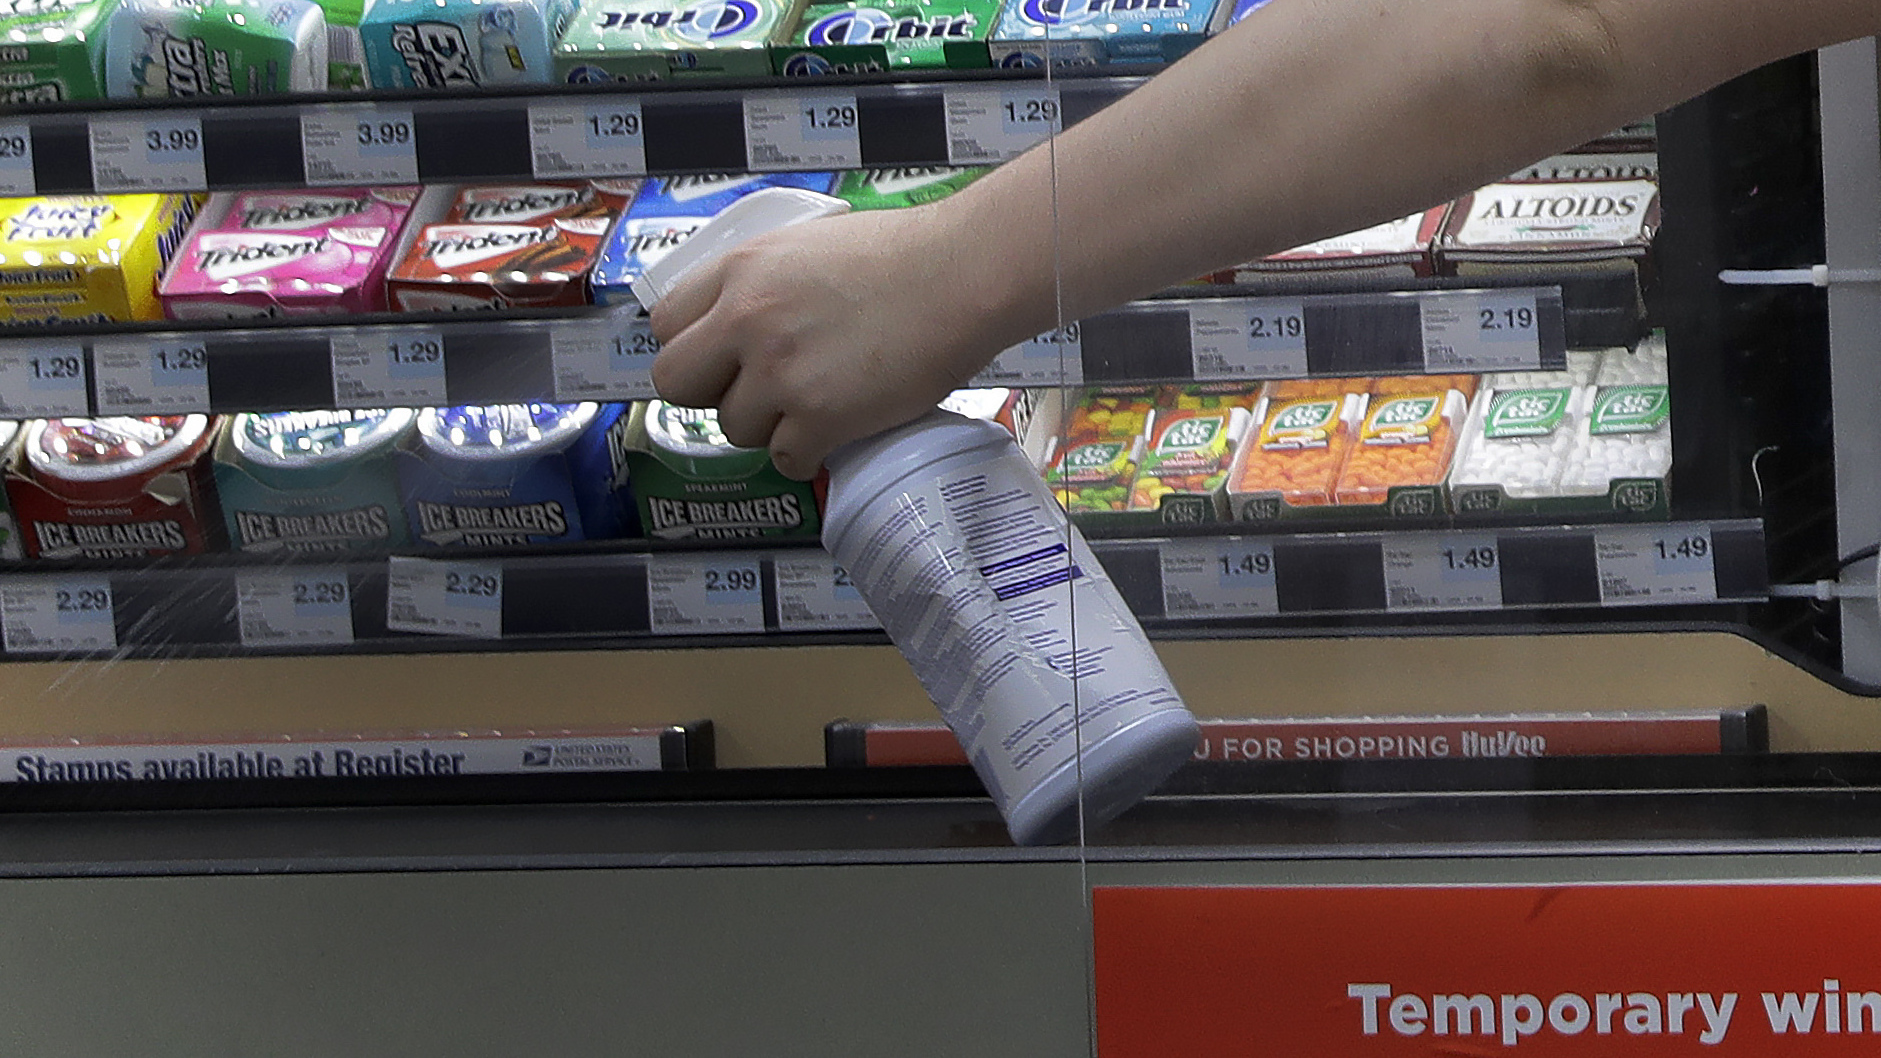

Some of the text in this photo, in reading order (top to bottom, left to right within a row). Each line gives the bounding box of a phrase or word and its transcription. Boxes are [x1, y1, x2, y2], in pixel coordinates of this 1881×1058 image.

[804, 6, 978, 47] Orbit
[804, 106, 856, 129] 1.29
[1004, 99, 1058, 123] 1.29
[358, 122, 410, 146] 3.99
[589, 114, 640, 137] 1.29
[0, 136, 26, 158] 29
[147, 128, 198, 151] 3.99
[243, 196, 370, 229] Trident
[462, 187, 594, 220] Trident
[1480, 194, 1640, 220] ALTOIDS
[427, 225, 558, 257] Trident
[200, 237, 331, 270] Trident
[1250, 316, 1302, 338] 2.19
[1480, 308, 1533, 331] 2.19
[388, 342, 440, 364] 1.29
[613, 333, 661, 356] 1.29
[29, 357, 81, 379] 1.29
[157, 347, 208, 370] 1.29
[417, 500, 566, 534] ICE BREAKERS
[648, 494, 799, 529] ICE BREAKERS
[34, 519, 187, 549] ICE BREAKERS
[236, 510, 277, 544] ICE
[1444, 546, 1496, 569] 1.49
[1656, 539, 1708, 562] 1.49
[833, 566, 855, 585] 2.
[1219, 553, 1271, 576] 1.49
[446, 572, 498, 596] 2.29
[705, 569, 757, 591] 2.99
[57, 589, 109, 611] 2.29
[294, 582, 346, 603] 2.29
[1224, 738, 1284, 760] FOR
[1295, 736, 1450, 760] SHOPPING
[16, 748, 466, 782] Stamps available at Register
[1348, 982, 1738, 1046] Temporary
